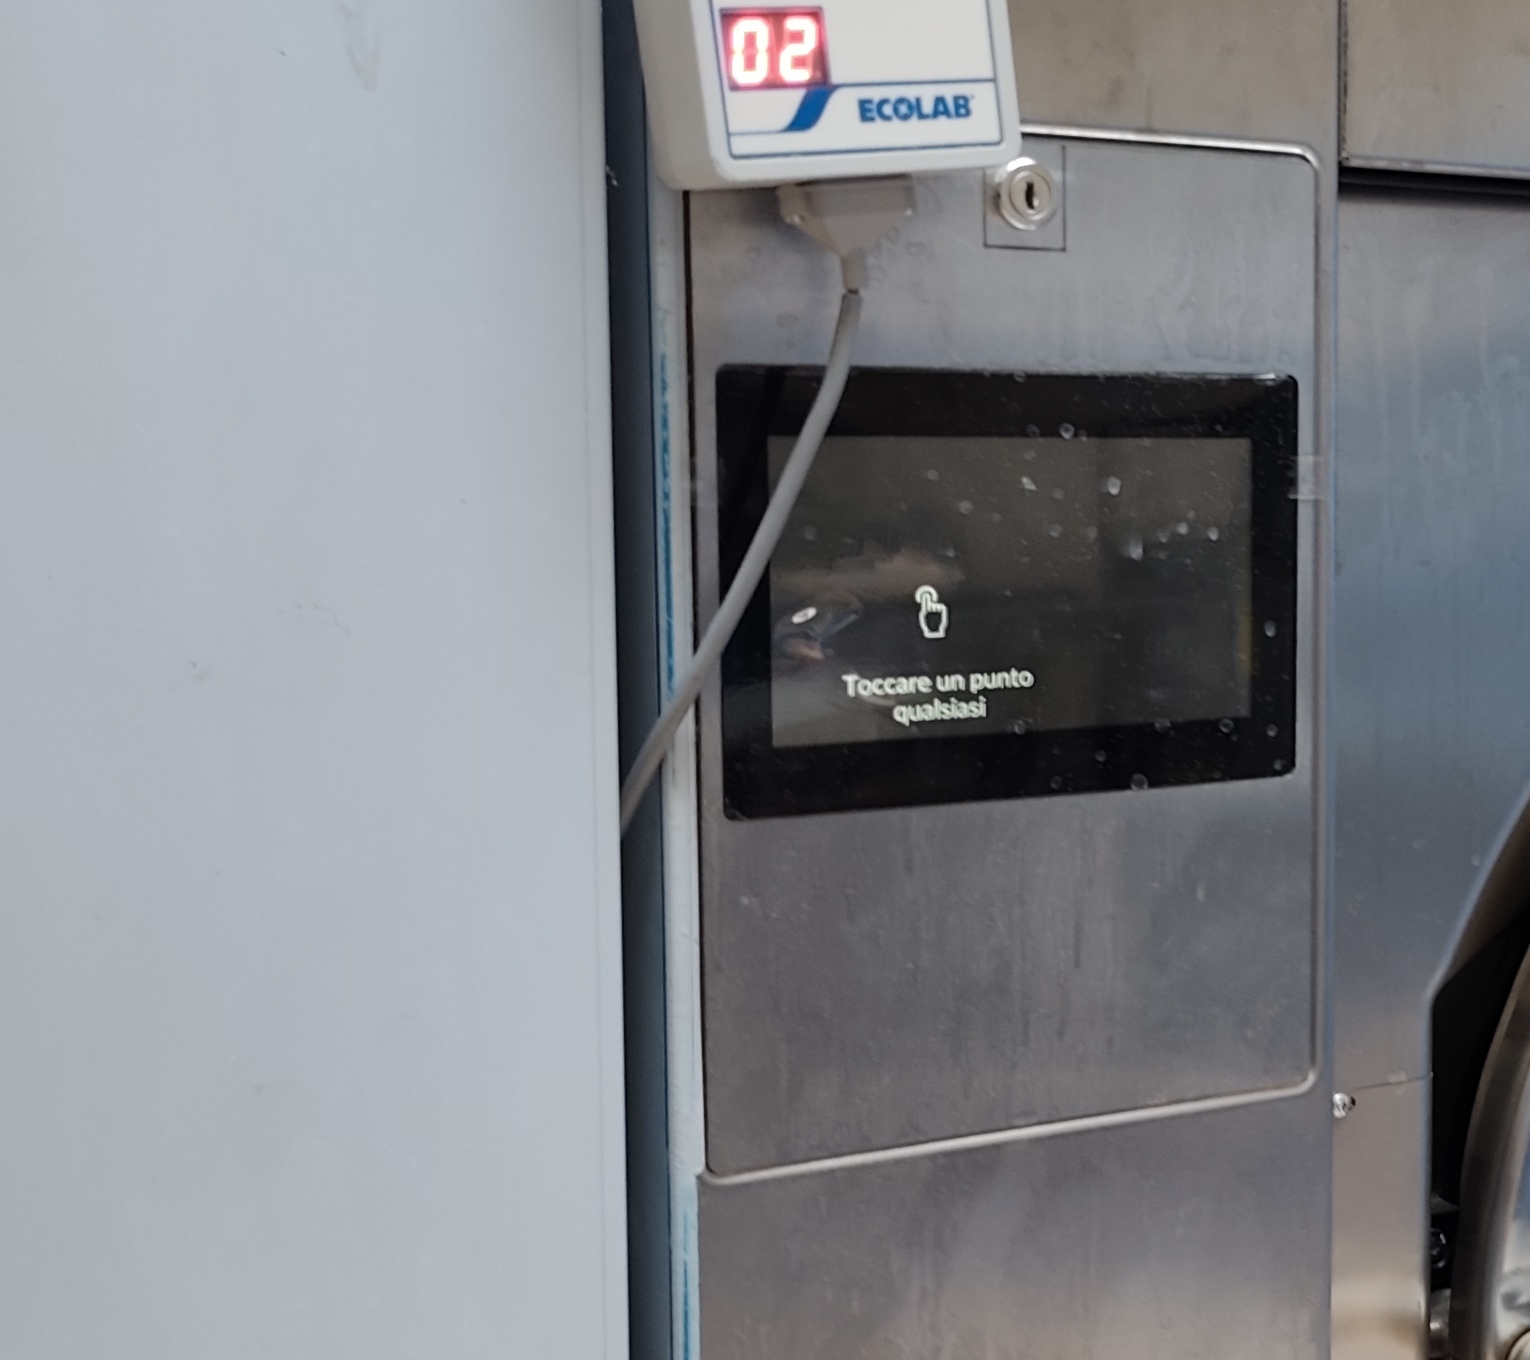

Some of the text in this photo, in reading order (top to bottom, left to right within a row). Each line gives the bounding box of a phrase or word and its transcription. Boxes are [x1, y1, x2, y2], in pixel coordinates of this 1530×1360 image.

[729, 15, 818, 86] 02
[857, 94, 973, 124] ECOLAB
[841, 666, 1035, 698] Toccare un punto
[892, 694, 988, 728] qualsiasi
